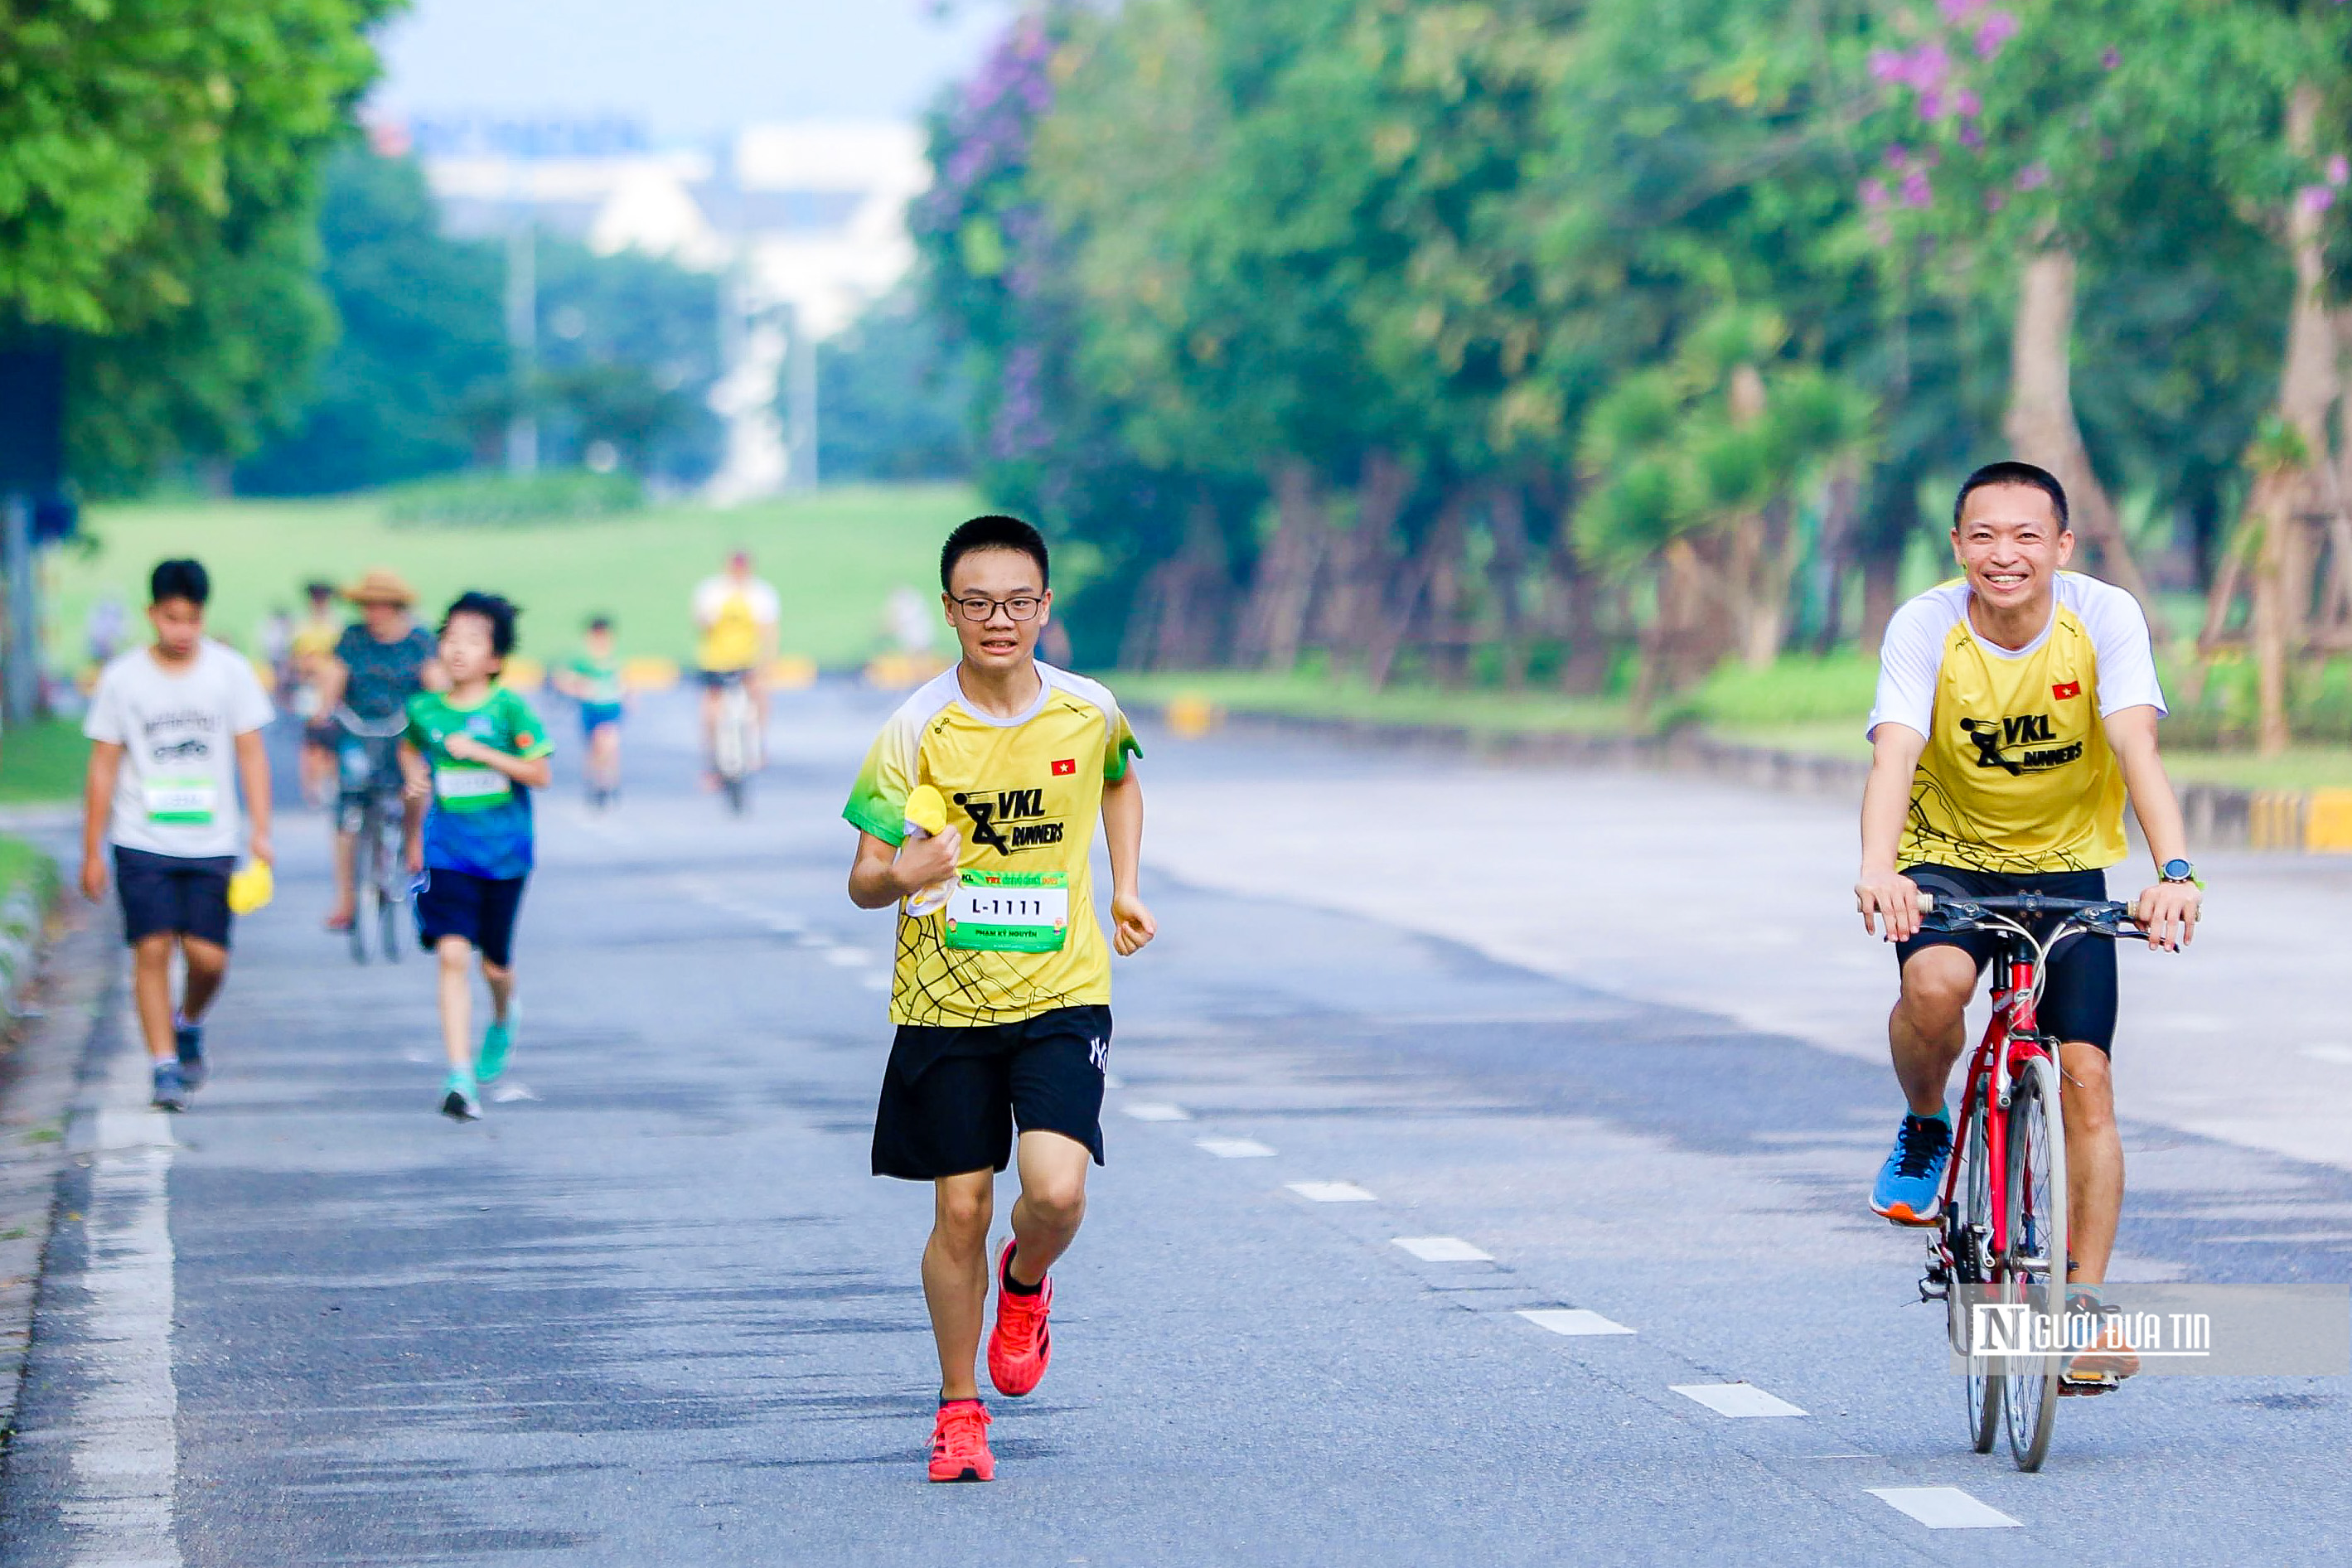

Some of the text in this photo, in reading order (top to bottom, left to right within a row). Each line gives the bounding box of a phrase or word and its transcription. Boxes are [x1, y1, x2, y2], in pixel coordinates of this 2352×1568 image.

[2002, 714, 2057, 745] VKL
[2023, 740, 2083, 767] RUNNERS
[998, 788, 1046, 820] VKL
[1011, 821, 1064, 847] RUNNERS
[961, 874, 974, 883] KL
[972, 898, 1040, 915] L-1111
